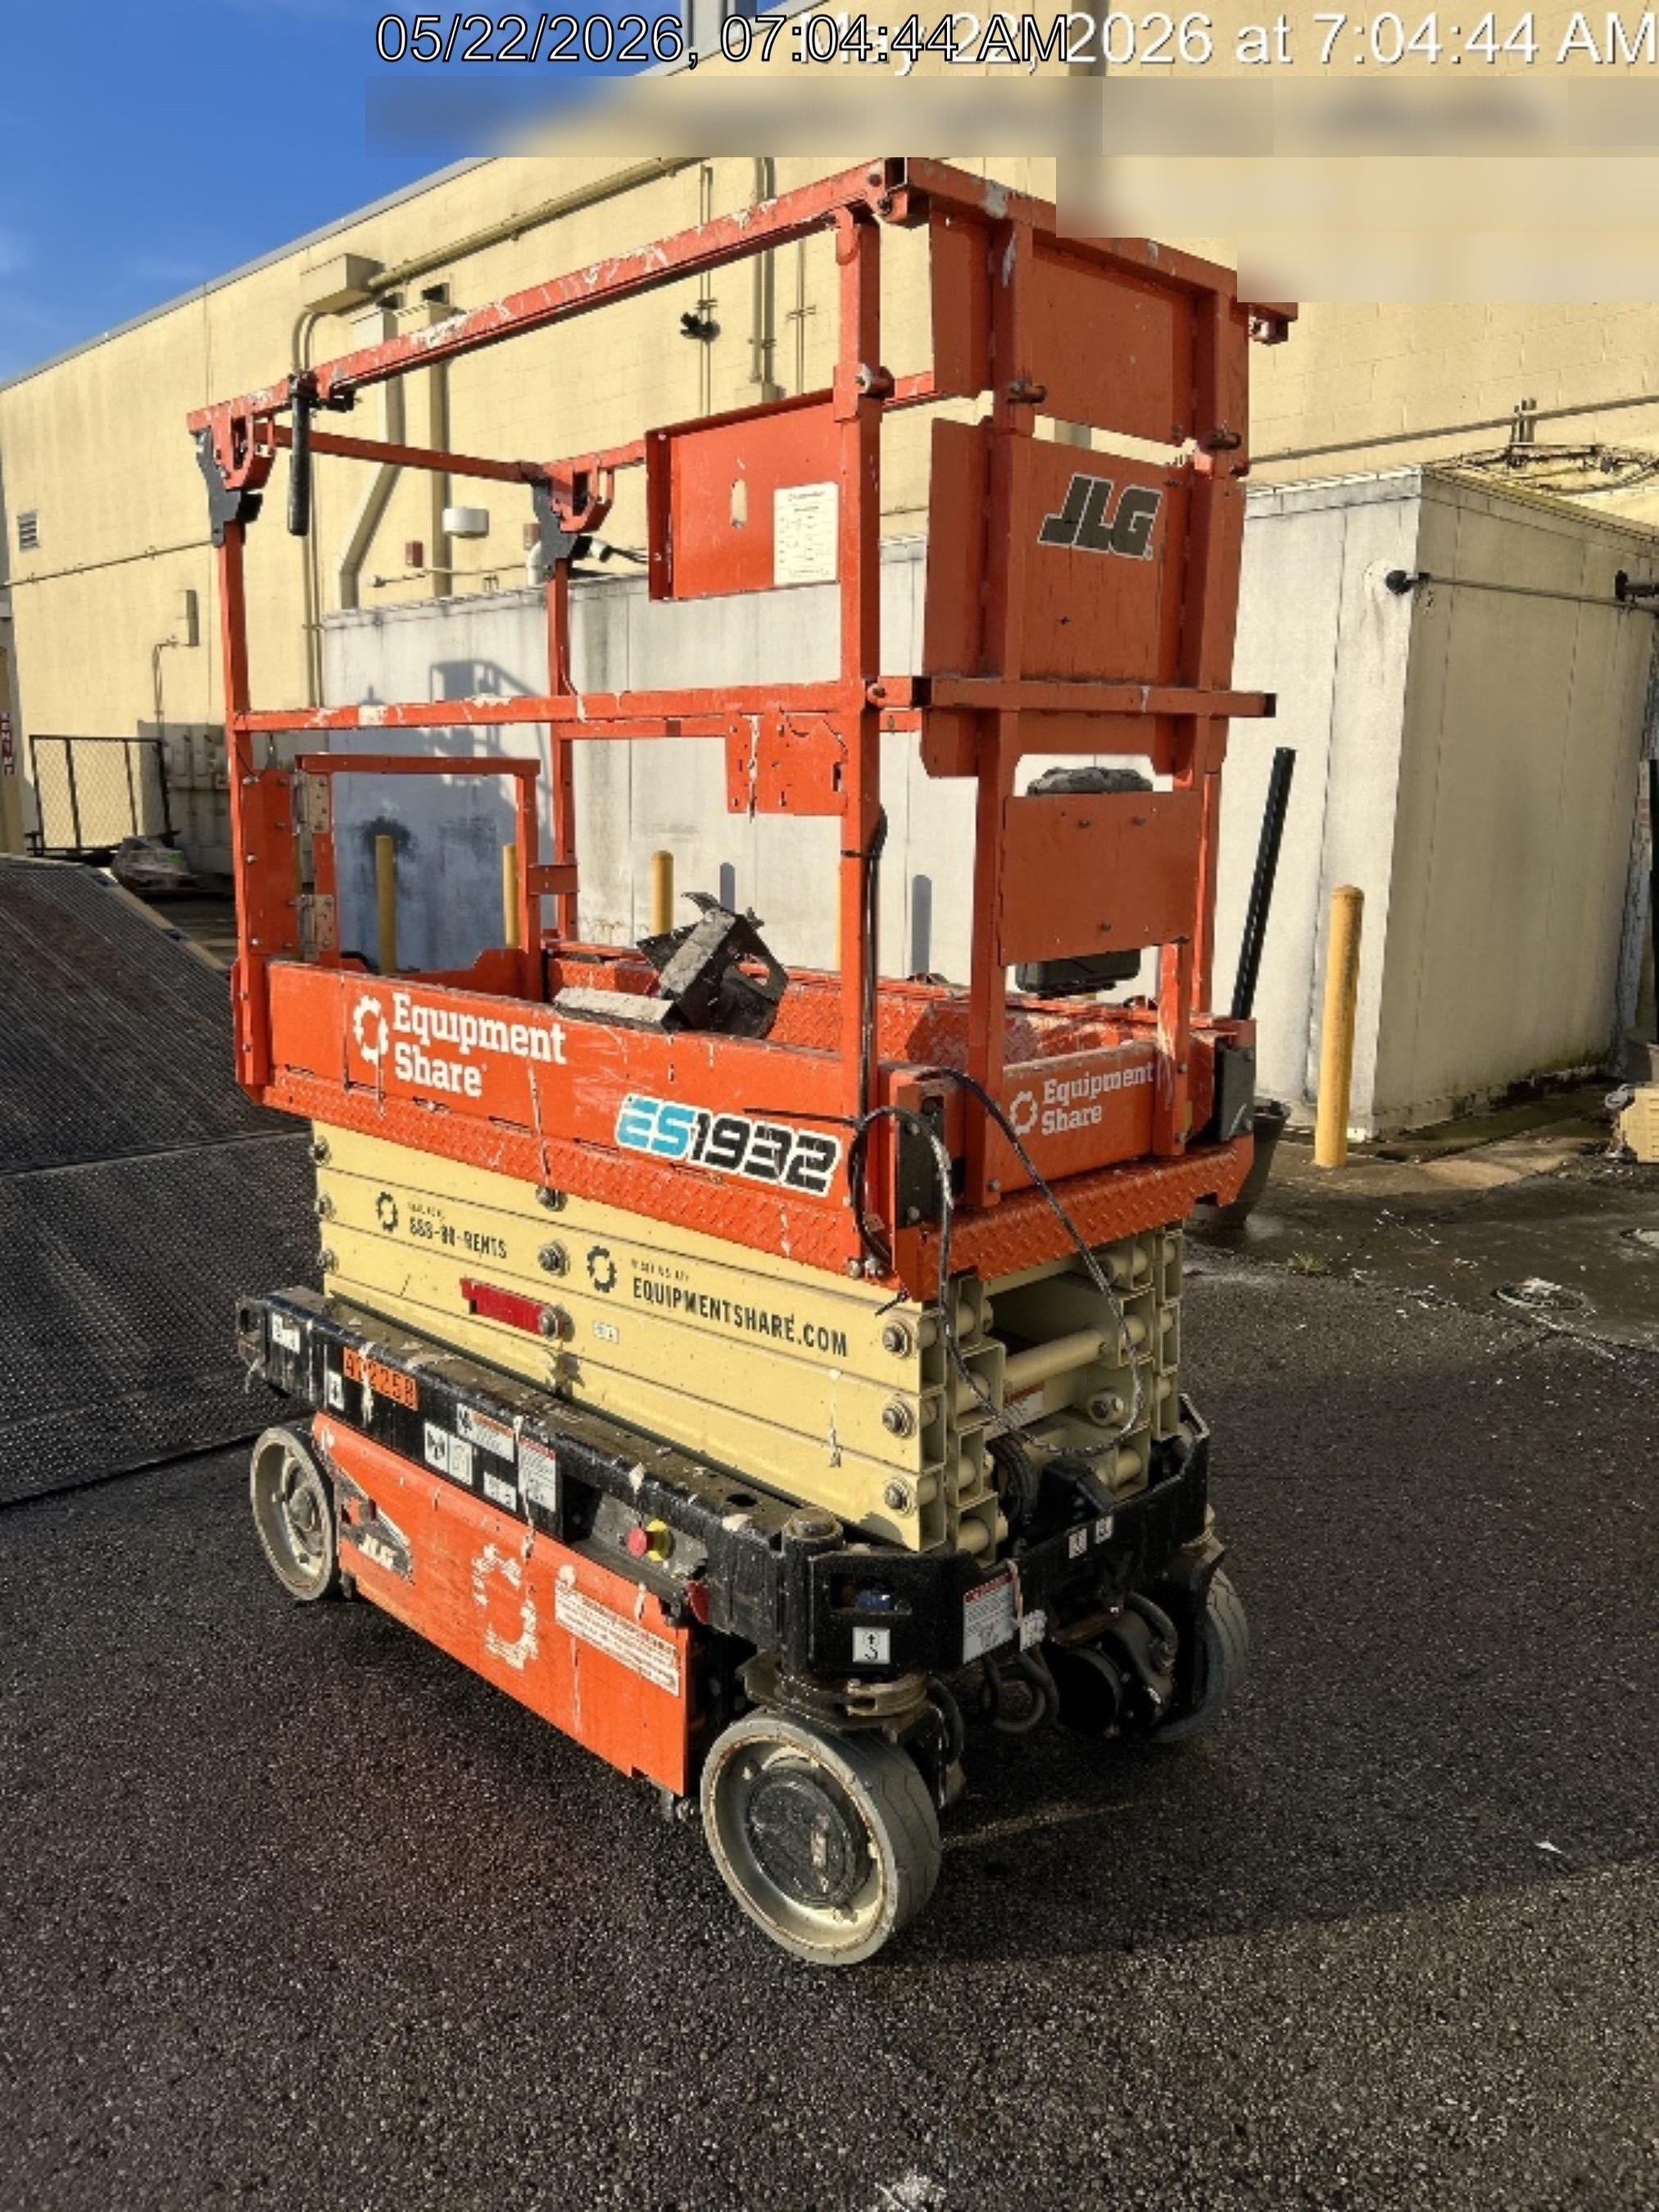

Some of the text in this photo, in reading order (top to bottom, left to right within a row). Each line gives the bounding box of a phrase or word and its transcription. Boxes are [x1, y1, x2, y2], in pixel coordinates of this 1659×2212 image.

[1038, 473, 1163, 560] JLG
[392, 992, 567, 1064] Equipment
[394, 1041, 483, 1098] Share
[1042, 1061, 1154, 1106] Equipment
[615, 1093, 842, 1198] ES1932
[1040, 1104, 1103, 1135] Share
[632, 1277, 848, 1357] EQUIPMENTSHARE.COM
